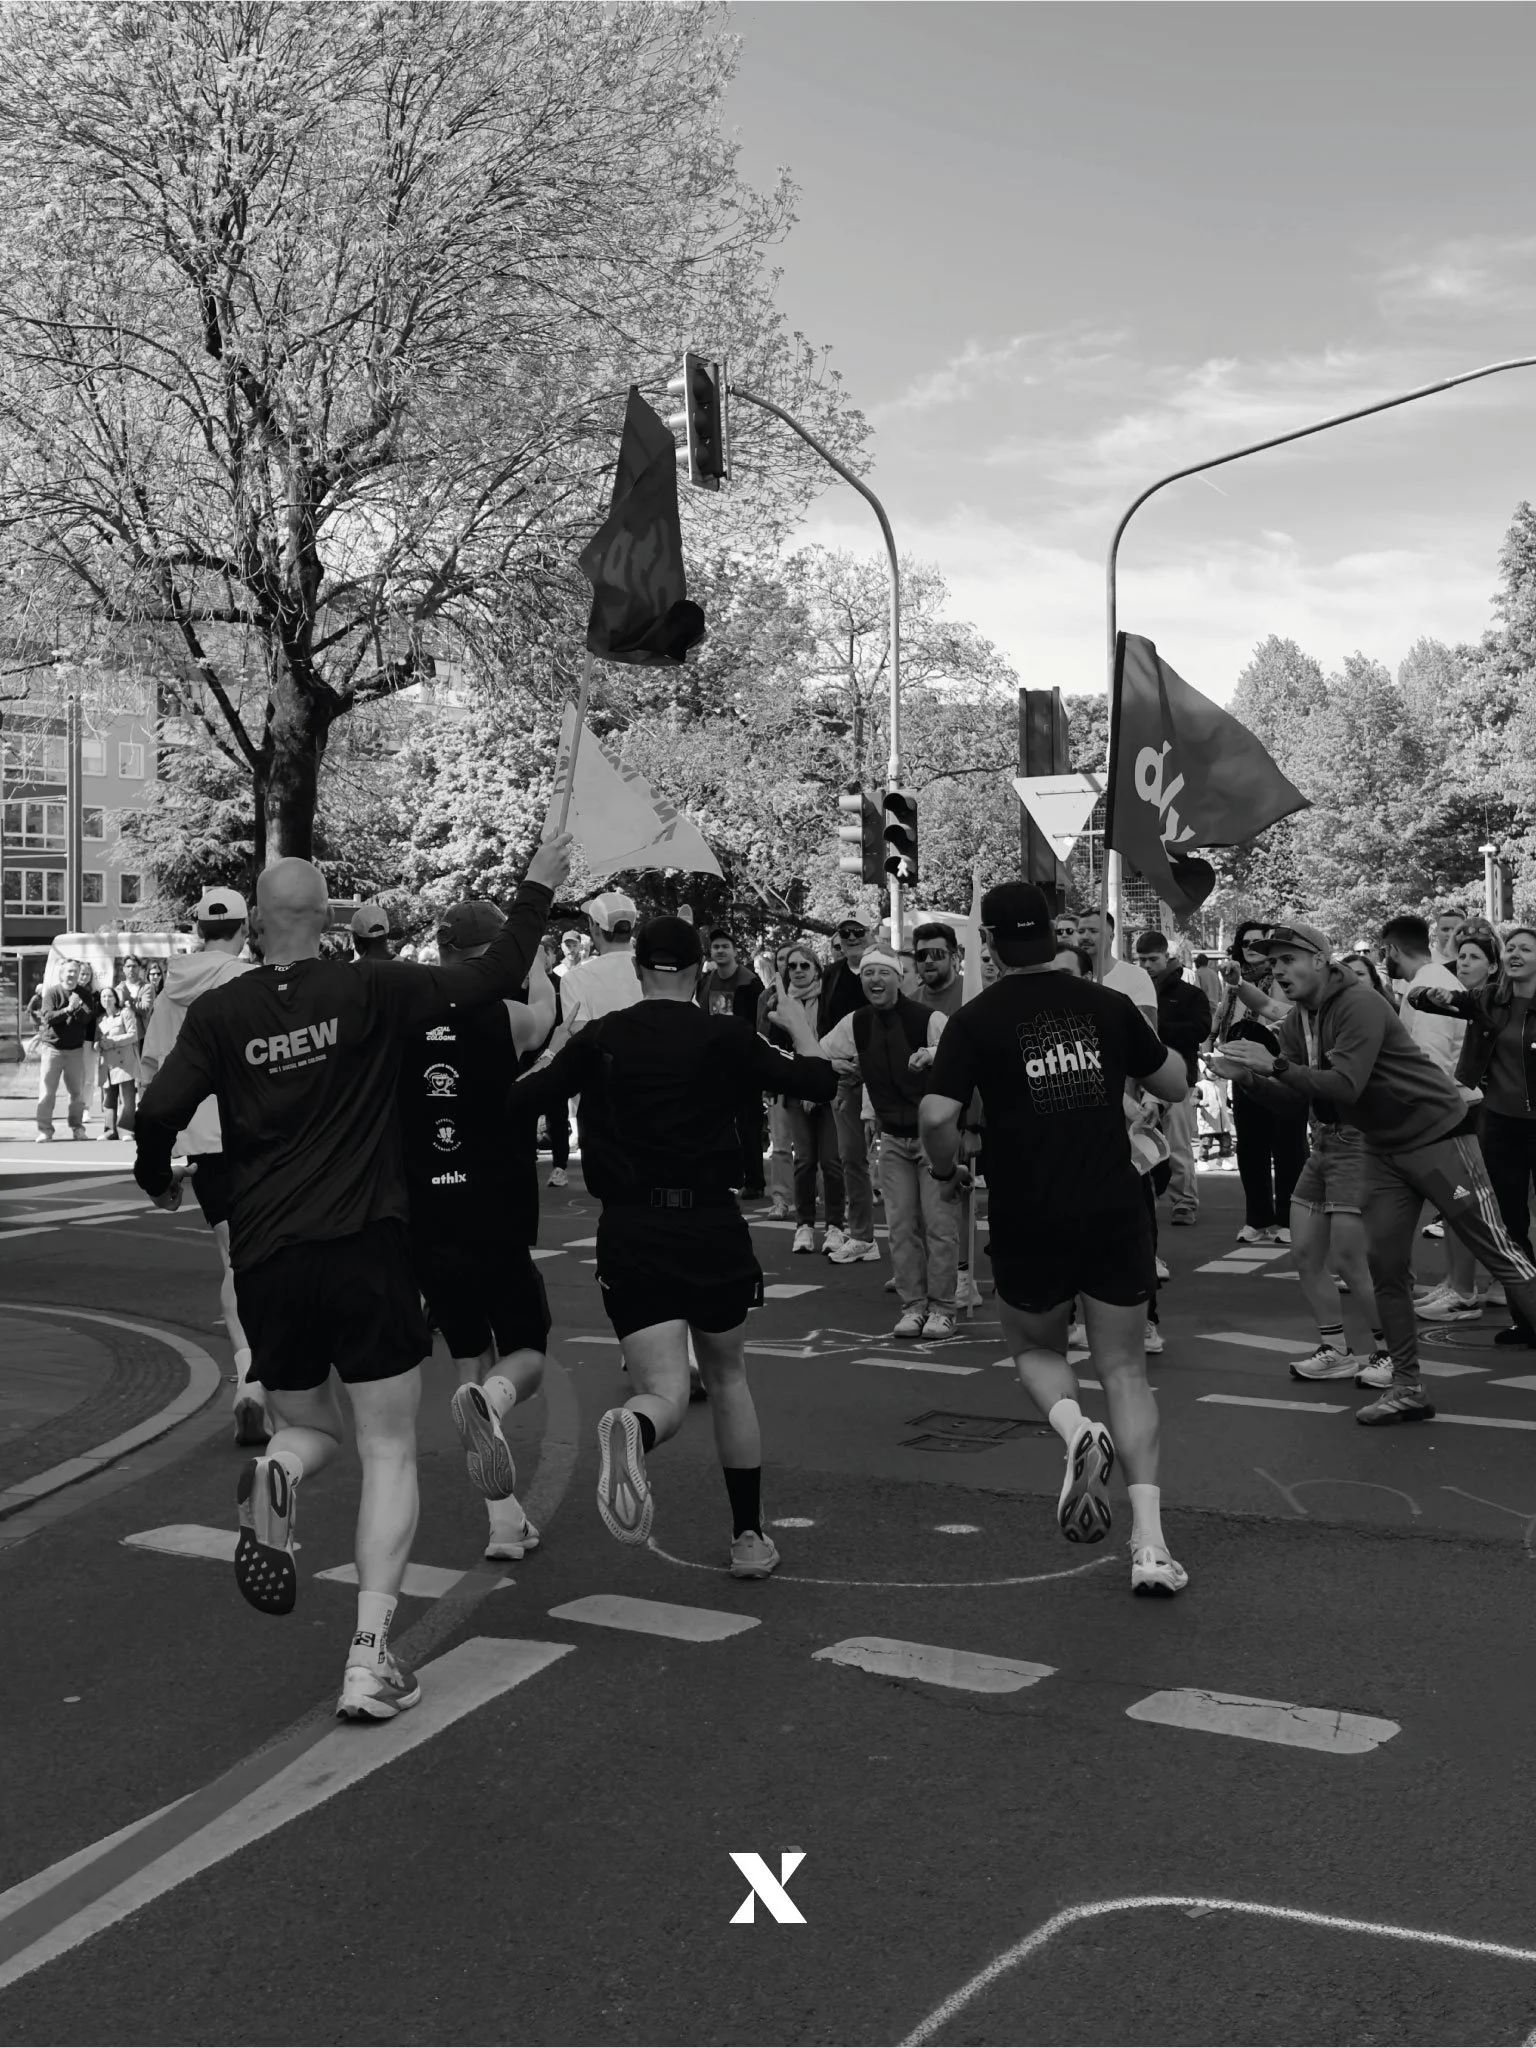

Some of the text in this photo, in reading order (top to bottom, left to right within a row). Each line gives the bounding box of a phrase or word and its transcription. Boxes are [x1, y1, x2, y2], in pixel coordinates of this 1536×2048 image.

[245, 1017, 338, 1065] CREW
[1025, 1040, 1102, 1078] athlx
[431, 1170, 467, 1184] athlx
